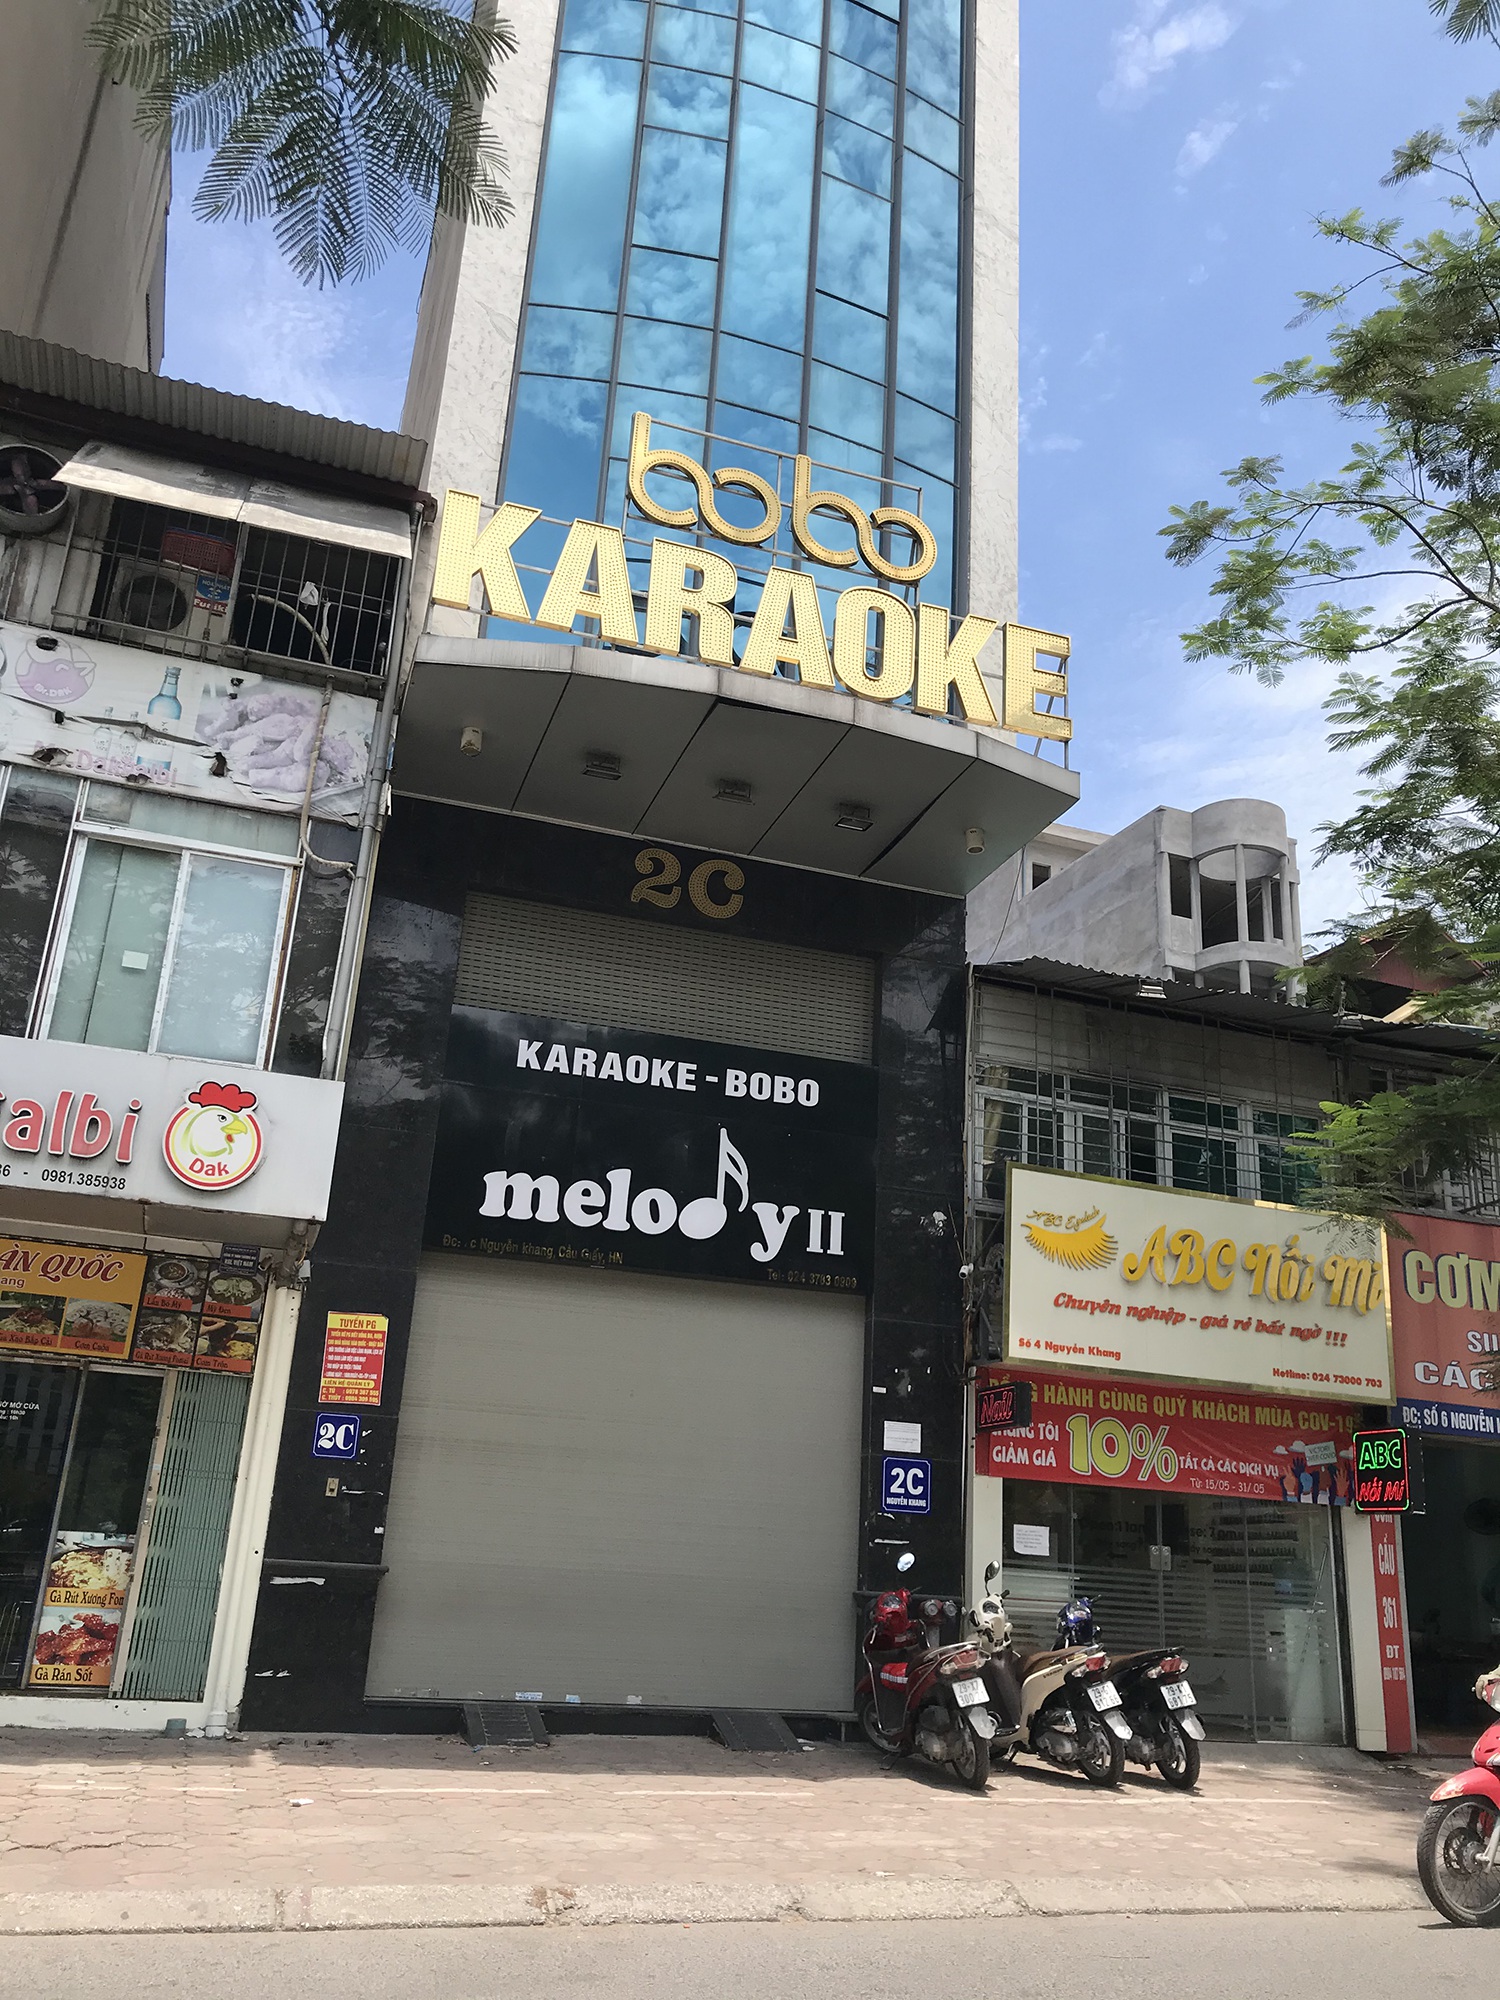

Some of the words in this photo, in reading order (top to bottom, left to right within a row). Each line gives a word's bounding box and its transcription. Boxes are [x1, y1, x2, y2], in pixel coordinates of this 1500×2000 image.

[432, 488, 1072, 741] KARAOKE
[631, 847, 746, 919] 2C
[516, 1039, 698, 1092] KARAOKE
[705, 1075, 719, 1083] -
[725, 1068, 820, 1107] BOBO
[0, 1090, 142, 1163] albi
[41, 1168, 127, 1190] 0981.385938
[188, 1157, 229, 1178] Dak
[806, 1208, 845, 1256] II
[38, 1252, 124, 1283] QUỐC
[608, 1251, 623, 1264] HN
[1121, 1225, 1237, 1291] ABC
[1242, 1234, 1317, 1304] Nối
[1321, 1254, 1383, 1316] Mi
[365, 1320, 377, 1330] PG
[1054, 1292, 1121, 1315] Chuyên
[1126, 1305, 1187, 1326] nghiệp
[1199, 1314, 1229, 1330] giá
[1255, 1319, 1285, 1336] bất
[1289, 1323, 1323, 1341] ngờ
[1325, 1330, 1348, 1347] !!!
[1018, 1337, 1031, 1348] Số
[1034, 1339, 1041, 1349] 4
[1088, 1346, 1121, 1361] Khang
[1272, 1367, 1310, 1380] Hotline:
[1312, 1372, 1330, 1383] 024
[1333, 1374, 1362, 1386] 73000
[1365, 1377, 1382, 1388] 703
[981, 1390, 1013, 1424] Nail
[1044, 1382, 1094, 1408] HÀNH
[1099, 1387, 1148, 1413] CÙNG
[1153, 1394, 1187, 1417] QUÝ
[1192, 1400, 1251, 1424] KHÁCH
[1255, 1404, 1294, 1428] MÙA
[1423, 1404, 1438, 1427] SỐ
[1441, 1411, 1448, 1427] 6
[1450, 1409, 1494, 1434] NGUYỄN
[317, 1422, 355, 1450] 2C
[1038, 1420, 1060, 1441] TÔI
[992, 1442, 1030, 1465] GIẢM
[1032, 1447, 1057, 1467] GIÁ
[1066, 1413, 1179, 1482] 10%
[1359, 1438, 1402, 1470] ABC
[1178, 1452, 1199, 1470] TẤT
[1217, 1458, 1237, 1473] CÁC
[1239, 1460, 1261, 1477] DỊCH
[1264, 1463, 1279, 1478] VỤ
[889, 1467, 925, 1496] 2C
[1205, 1479, 1230, 1491] 15/05
[1252, 1483, 1265, 1494] 05
[1384, 1478, 1405, 1502] Mi
[50, 1590, 62, 1603] Gà
[64, 1590, 79, 1604] Rút
[80, 1591, 107, 1607] Xương
[1382, 1597, 1398, 1628] 361
[1386, 1645, 1399, 1659] ĐT
[35, 1667, 48, 1681] Gà
[52, 1667, 71, 1681] Rán
[74, 1667, 93, 1682] Sốt
